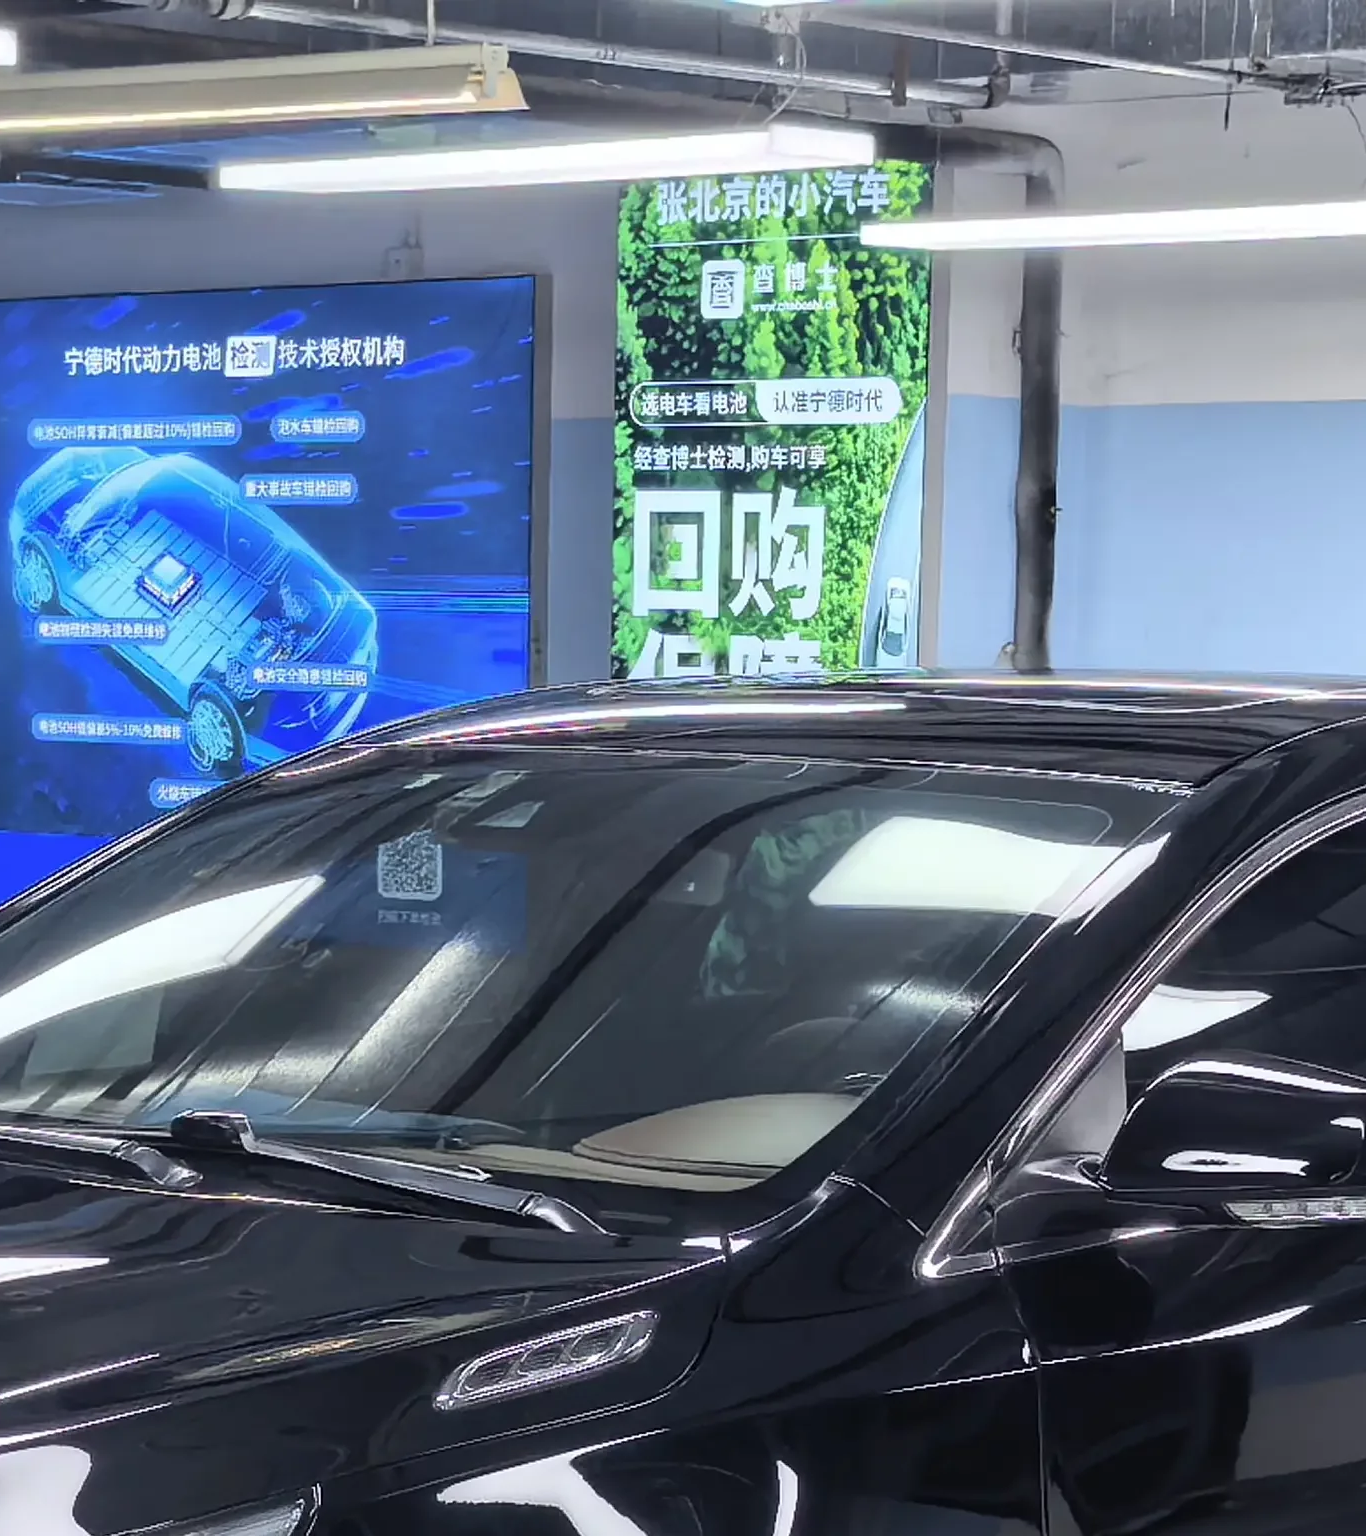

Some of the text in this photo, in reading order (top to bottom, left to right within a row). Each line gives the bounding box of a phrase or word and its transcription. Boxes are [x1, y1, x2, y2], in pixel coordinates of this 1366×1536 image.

[657, 167, 890, 226] 张北京的小汽车
[641, 389, 884, 416] 选电车看电池 认准宁德时代
[632, 486, 826, 620] 回购
